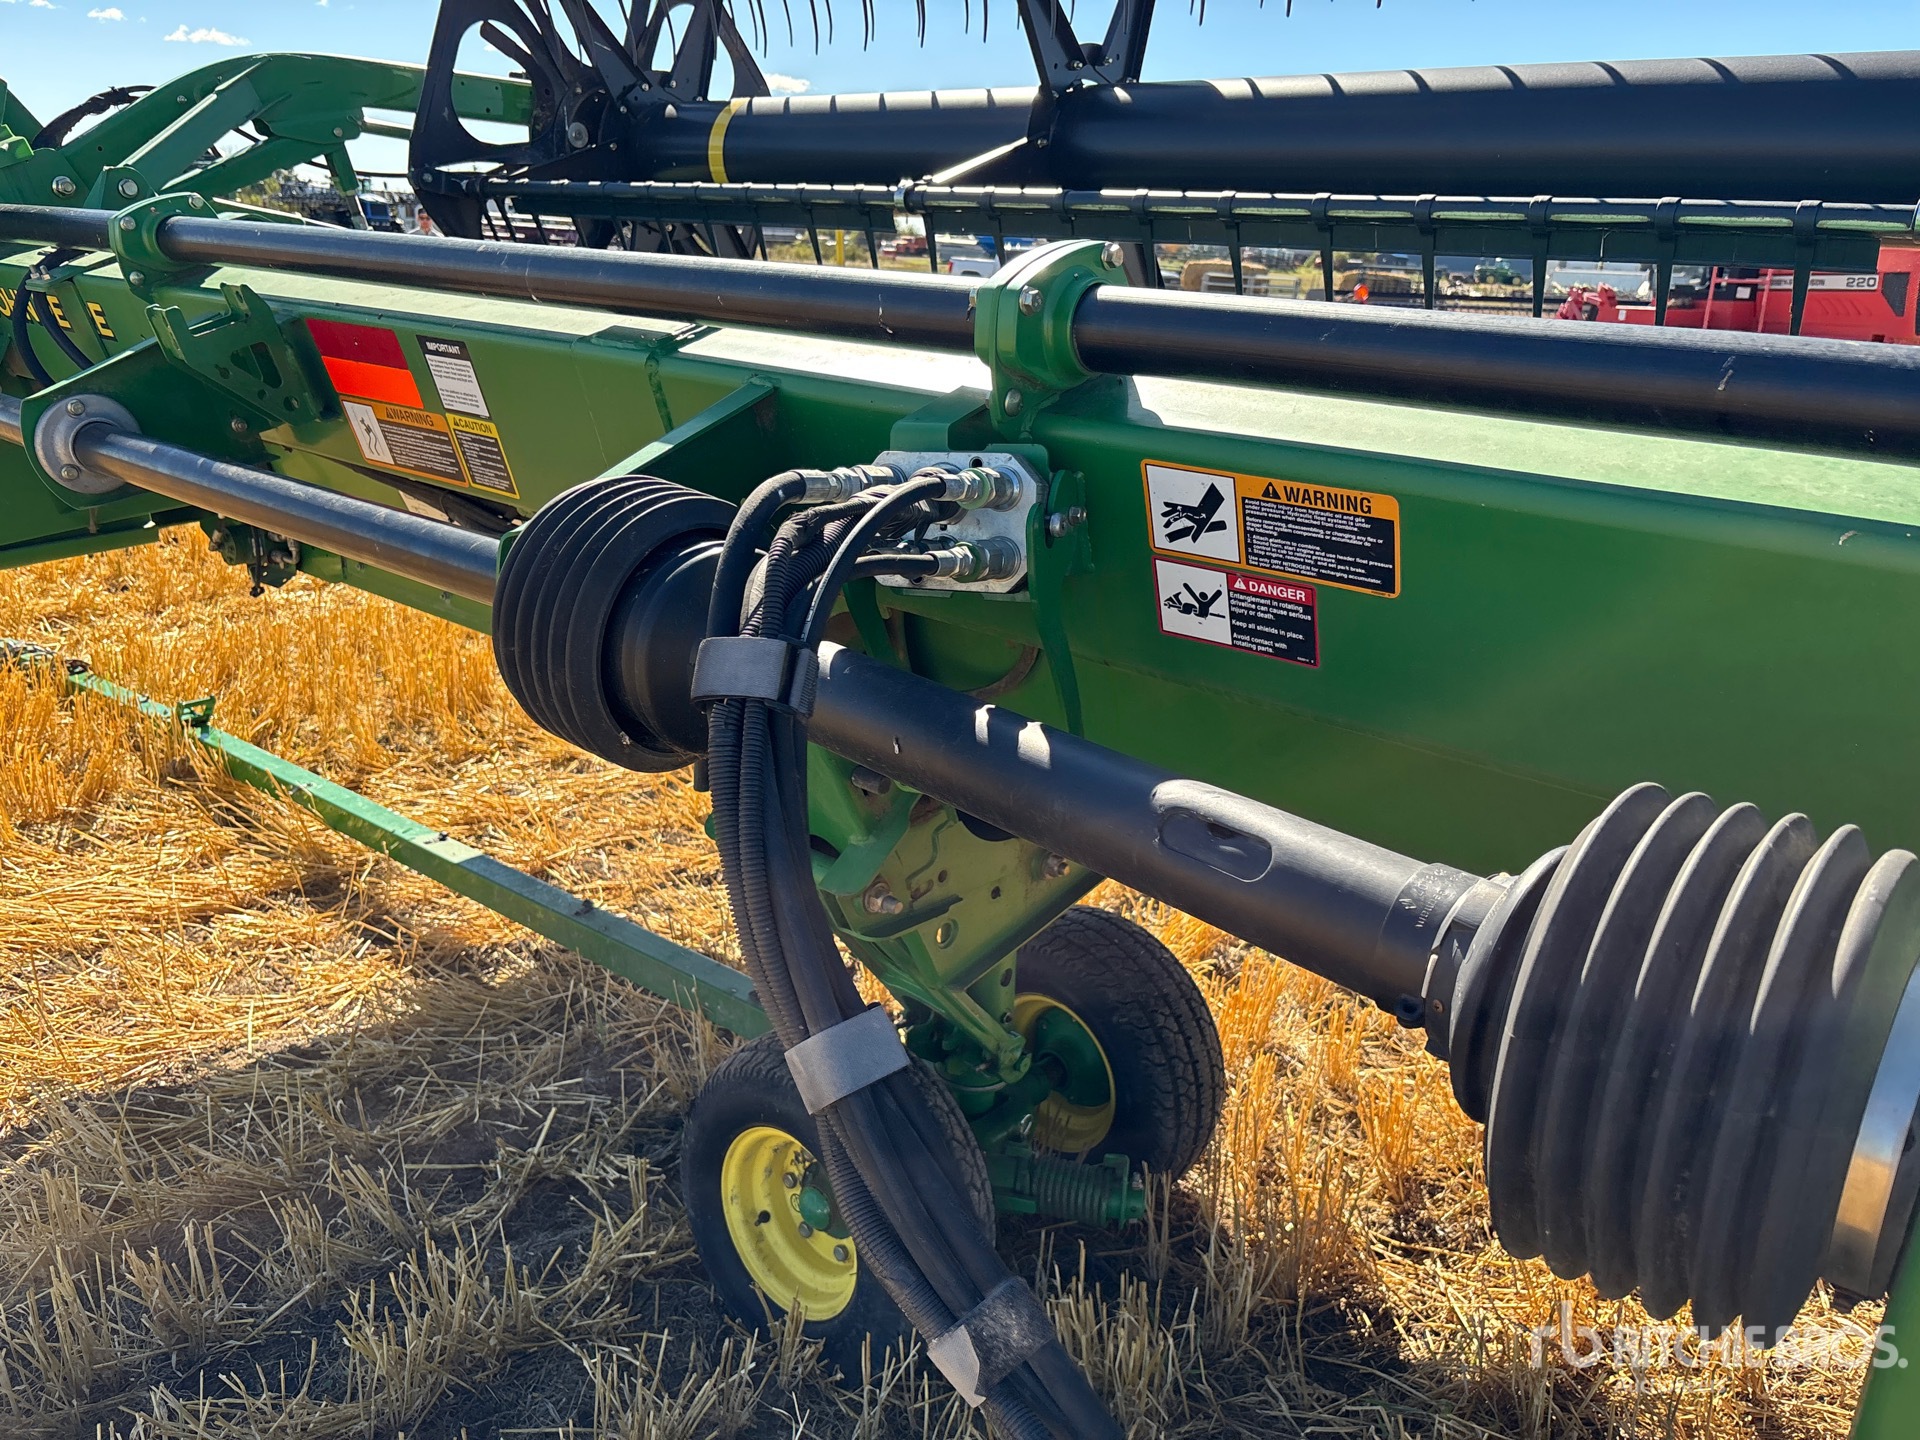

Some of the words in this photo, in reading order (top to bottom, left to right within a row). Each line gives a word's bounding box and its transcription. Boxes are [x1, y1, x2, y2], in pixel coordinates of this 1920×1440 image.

[1845, 277, 1877, 288] 220
[425, 341, 461, 355] IMPORTANT
[392, 409, 434, 426] WARNING
[458, 418, 492, 434] CAUTION
[1283, 486, 1371, 514] WARNING
[1287, 511, 1312, 519] Hydraulic
[1327, 517, 1347, 525] system
[1308, 509, 1333, 518] hydraulic
[1296, 517, 1320, 525] detached
[1274, 526, 1292, 534] system
[1293, 529, 1324, 539] components
[1332, 530, 1355, 540] changing
[1269, 538, 1290, 546] platform
[1297, 547, 1314, 555] engine
[1369, 561, 1392, 569] pressure
[1283, 561, 1310, 570] NITROGEN
[1320, 568, 1347, 578] recharging
[1249, 581, 1305, 601] DANGER
[1230, 591, 1270, 606] Entanglement
[1279, 602, 1303, 613] rotating
[1230, 599, 1255, 609] driveline
[1269, 607, 1287, 616] cause
[1289, 611, 1311, 621] serious
[1231, 606, 1247, 616] injury
[1257, 611, 1275, 620] death.
[1232, 619, 1247, 629] Keep
[1257, 624, 1278, 634] shields
[1287, 631, 1304, 641] place.
[1233, 632, 1250, 641] Avoid
[1251, 637, 1273, 646] contact
[1234, 639, 1256, 650] rotating
[1258, 645, 1274, 654] parts.
